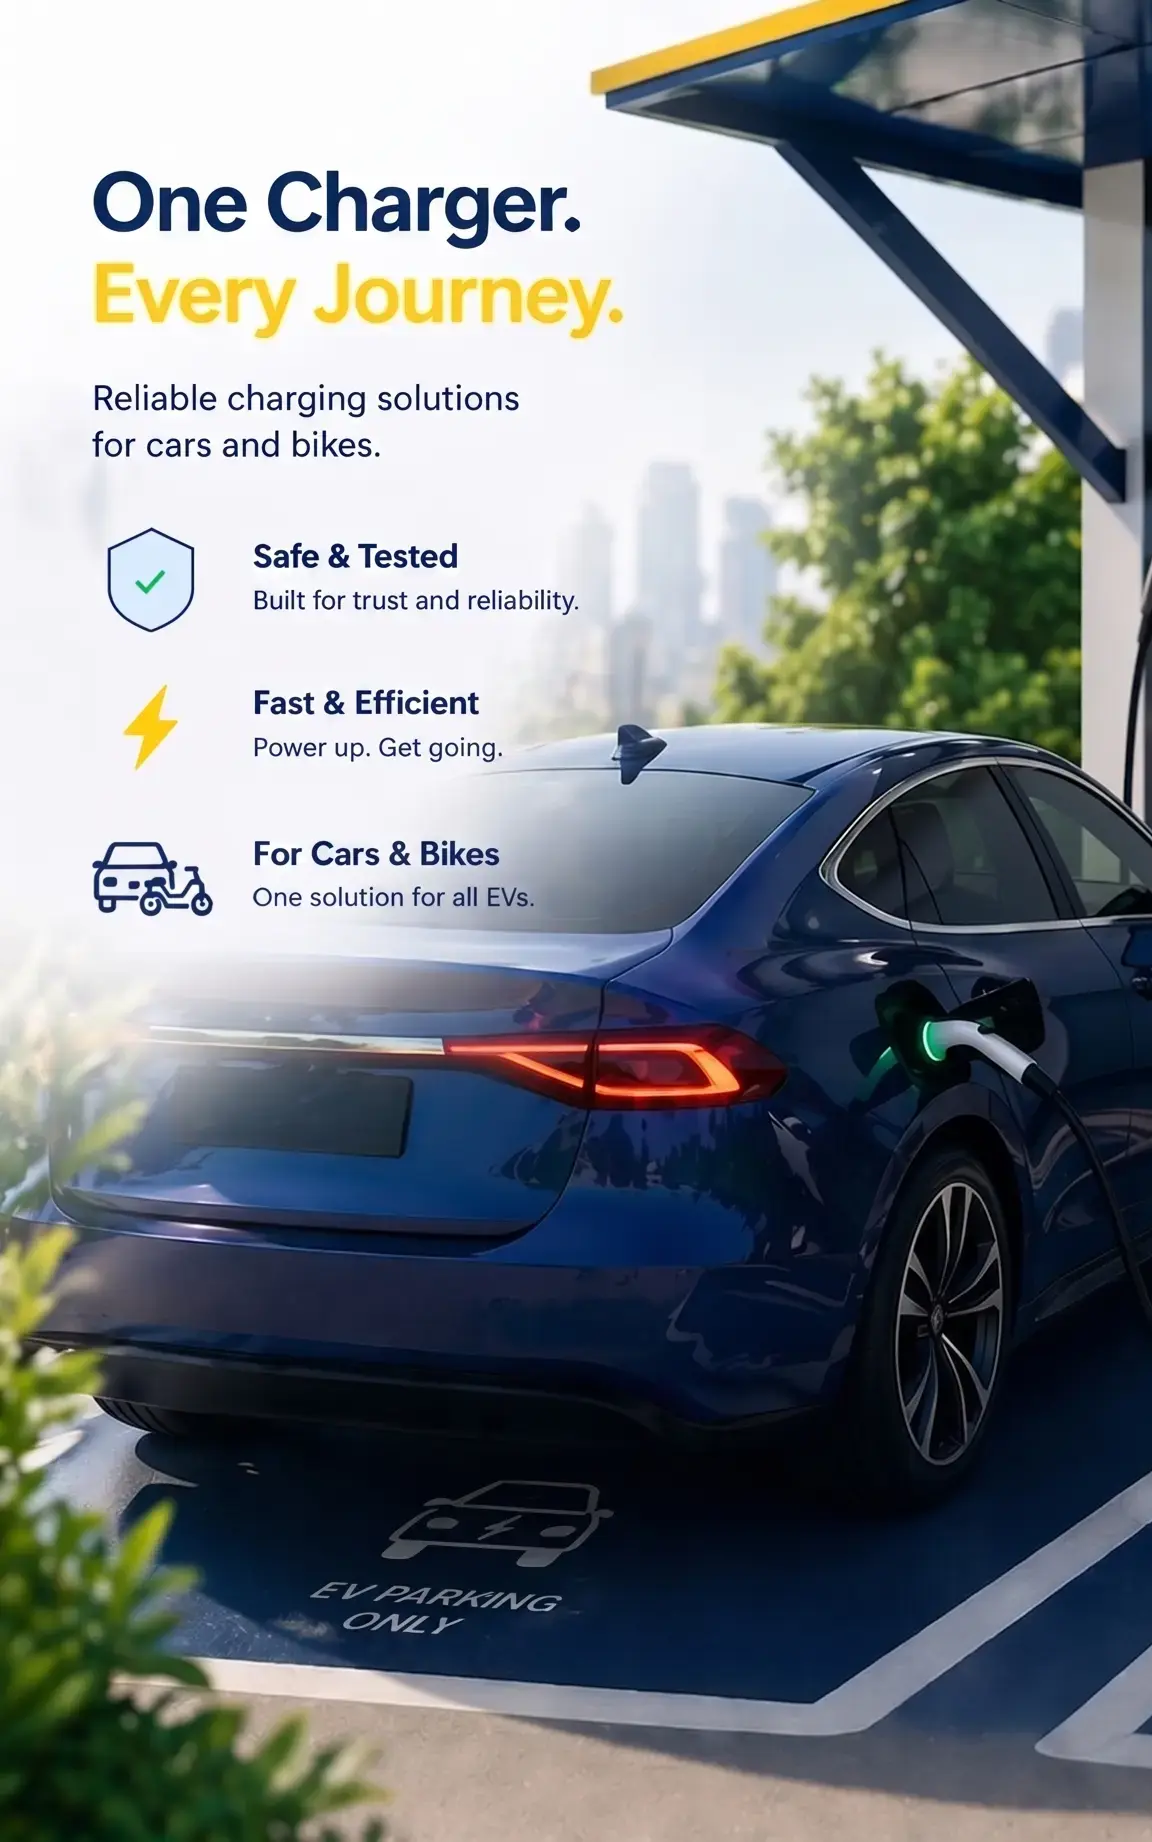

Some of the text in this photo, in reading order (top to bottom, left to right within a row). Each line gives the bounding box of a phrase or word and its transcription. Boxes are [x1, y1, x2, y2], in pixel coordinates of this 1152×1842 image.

[310, 1582, 562, 1613] EV PARKING
[343, 1612, 464, 1634] ONLY
